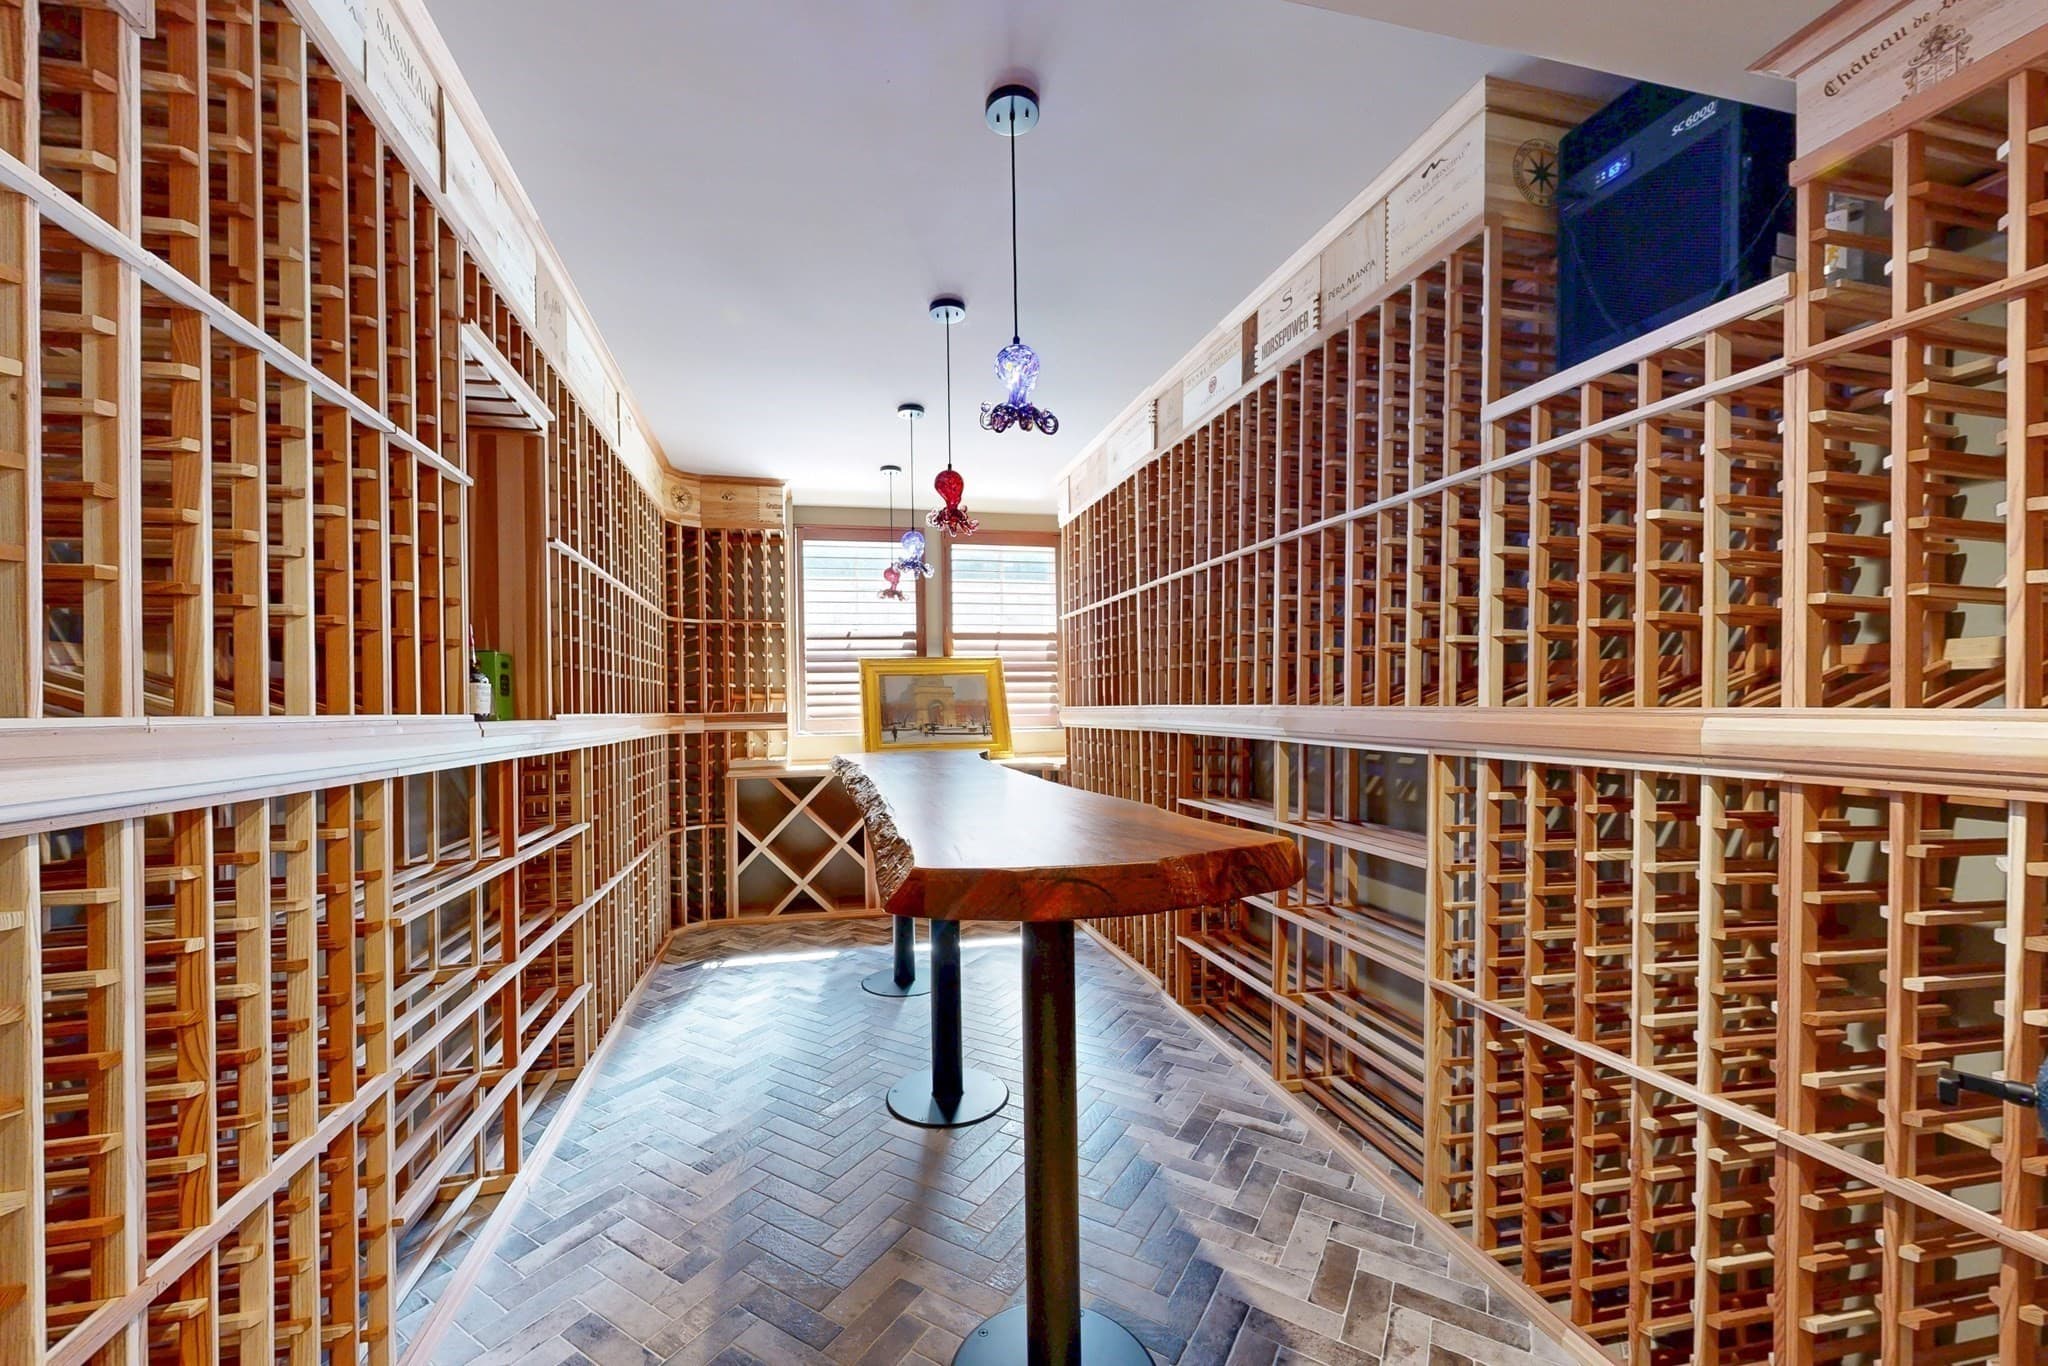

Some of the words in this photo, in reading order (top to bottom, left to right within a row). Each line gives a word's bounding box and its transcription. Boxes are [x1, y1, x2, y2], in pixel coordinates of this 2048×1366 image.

[1912, 12, 1931, 29] de
[376, 7, 435, 118] SASSICAIA
[1261, 310, 1309, 361] HORSEPOWER
